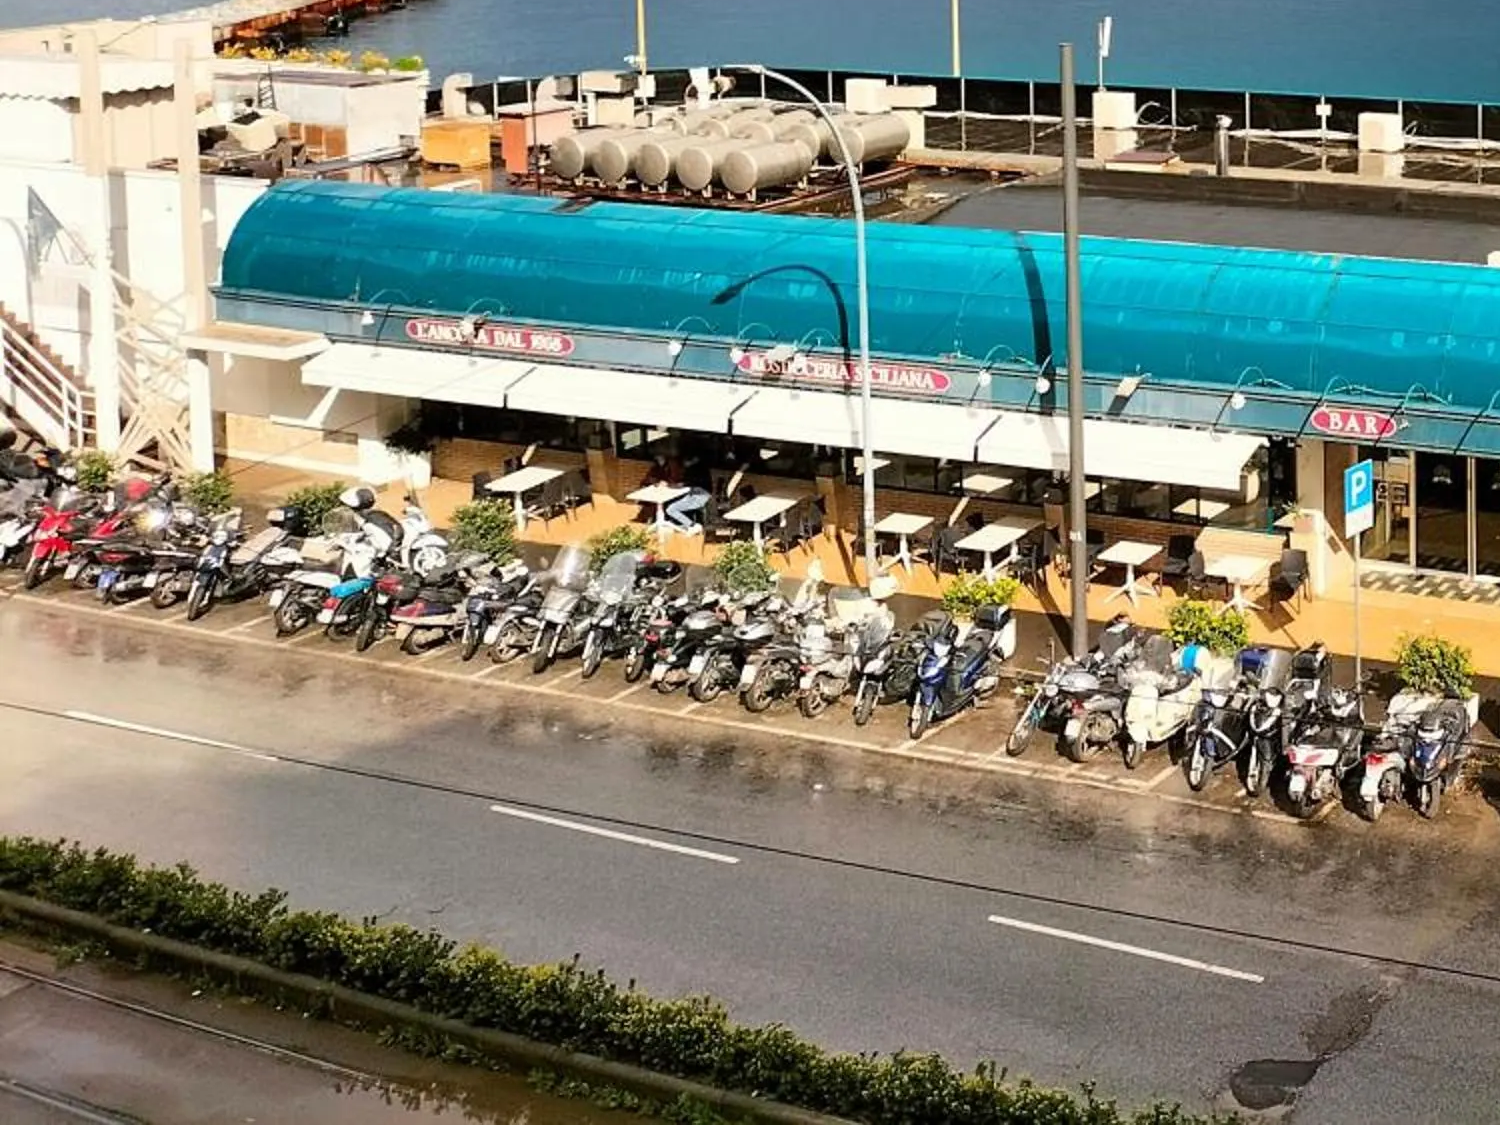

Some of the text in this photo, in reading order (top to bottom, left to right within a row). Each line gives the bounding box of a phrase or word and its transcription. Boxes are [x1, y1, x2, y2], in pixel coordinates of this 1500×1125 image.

[493, 330, 527, 348] DAL
[853, 366, 934, 390] SCILIANA
[1329, 412, 1378, 435] BAR
[1351, 470, 1367, 507] P
